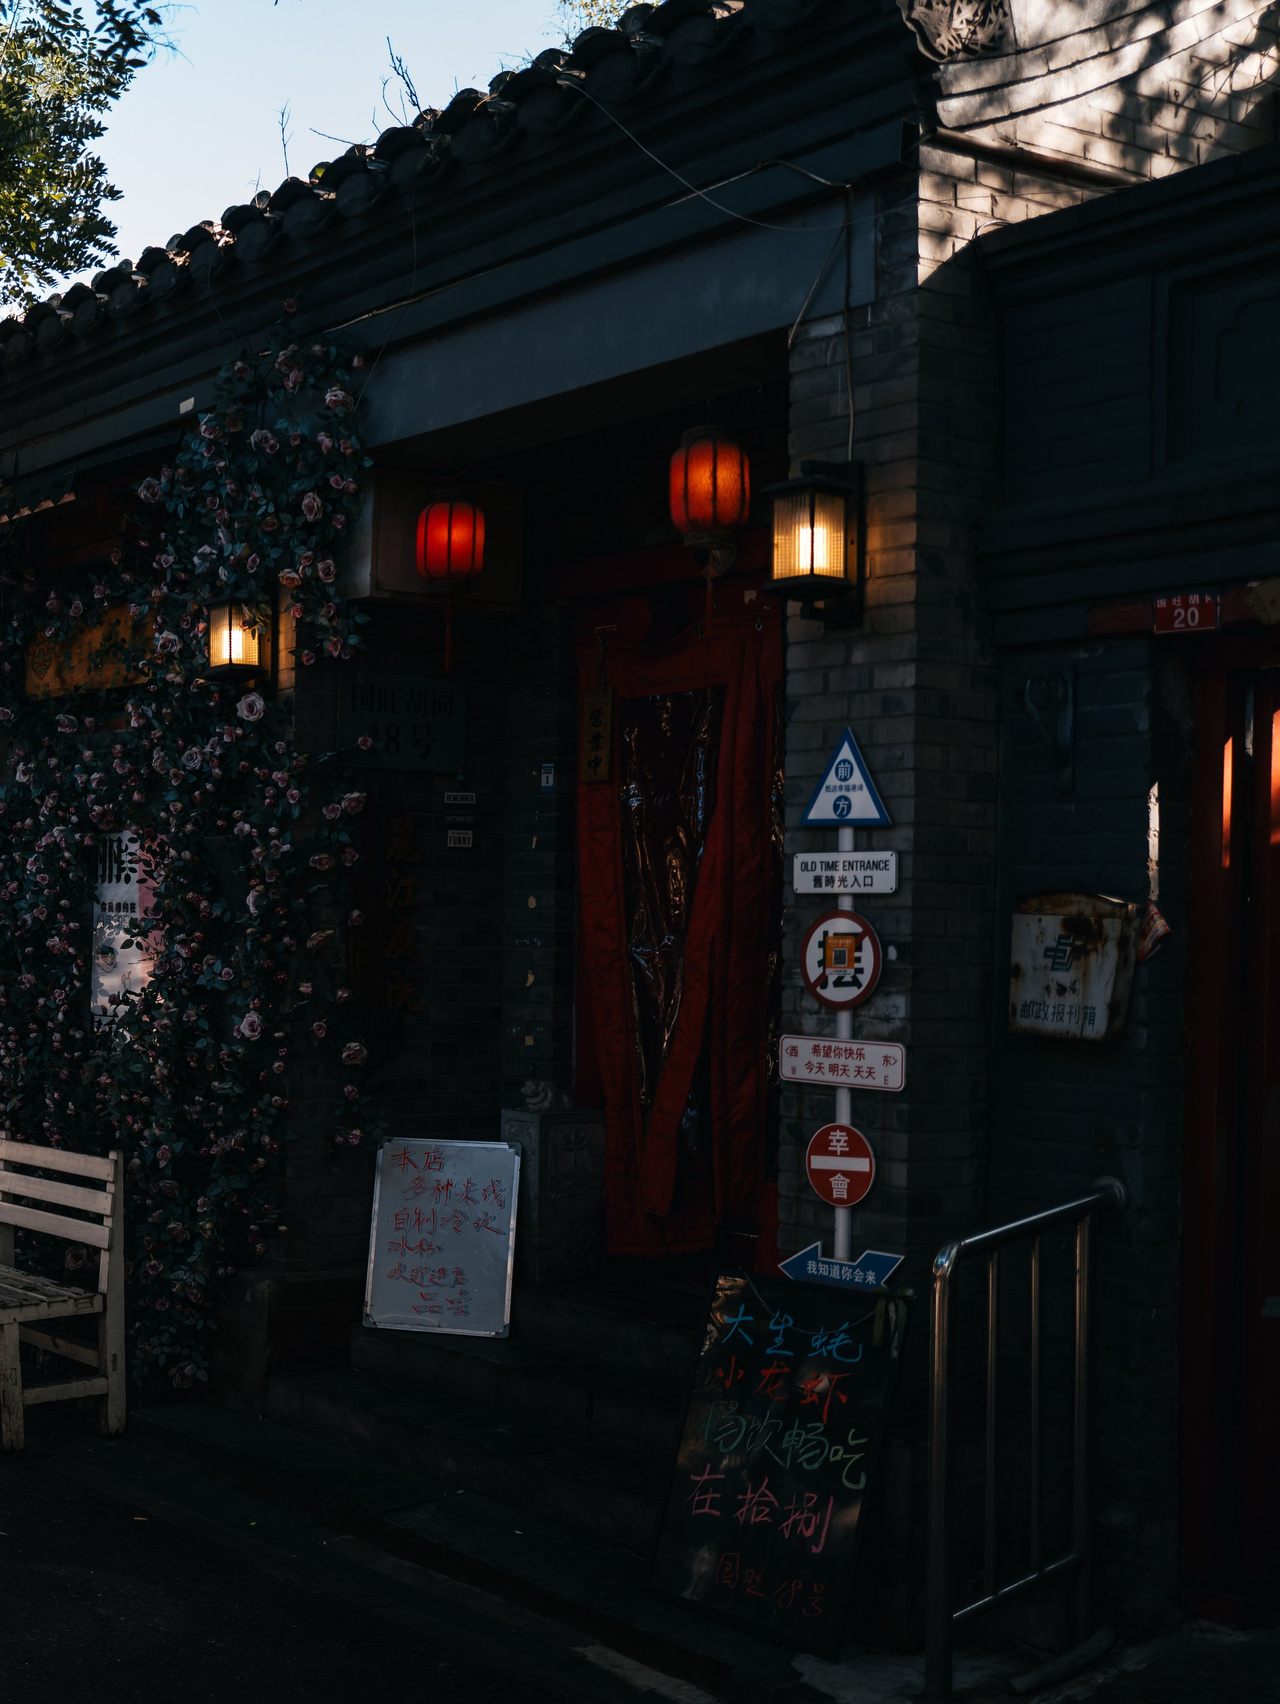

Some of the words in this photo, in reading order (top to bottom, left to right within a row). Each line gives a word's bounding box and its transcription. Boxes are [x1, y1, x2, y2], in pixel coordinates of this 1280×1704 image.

[1173, 606, 1199, 629] 20
[351, 683, 455, 719] 国旺胡同
[837, 762, 851, 780] 前
[835, 798, 850, 816] 方
[449, 835, 471, 846] FUNNY
[800, 860, 817, 872] OLD
[819, 860, 840, 872] TIME
[842, 859, 890, 871] ENTRANCE
[812, 875, 874, 888] 舊時光入口
[1020, 1000, 1097, 1028] 邮政报刊箱
[789, 1045, 799, 1058] 西
[811, 1043, 866, 1061] 希望你快乐
[882, 1054, 892, 1067] 东
[790, 1066, 797, 1075] W
[804, 1060, 825, 1076] 今天
[828, 1063, 850, 1078] 明天
[853, 1065, 876, 1081] 天天
[883, 1075, 890, 1085] E
[828, 1129, 850, 1156] 幸
[390, 1146, 445, 1174] 本店
[401, 1176, 506, 1209] 多种米线
[828, 1173, 851, 1200] 會
[394, 1207, 506, 1235] 自制冷饮
[386, 1263, 469, 1289] 欢迎进店
[806, 1260, 877, 1285] 我知道你会来
[721, 1304, 863, 1363] 大生蚝
[717, 1356, 853, 1425] 小龙虾
[686, 1463, 834, 1555] 在拾捌
